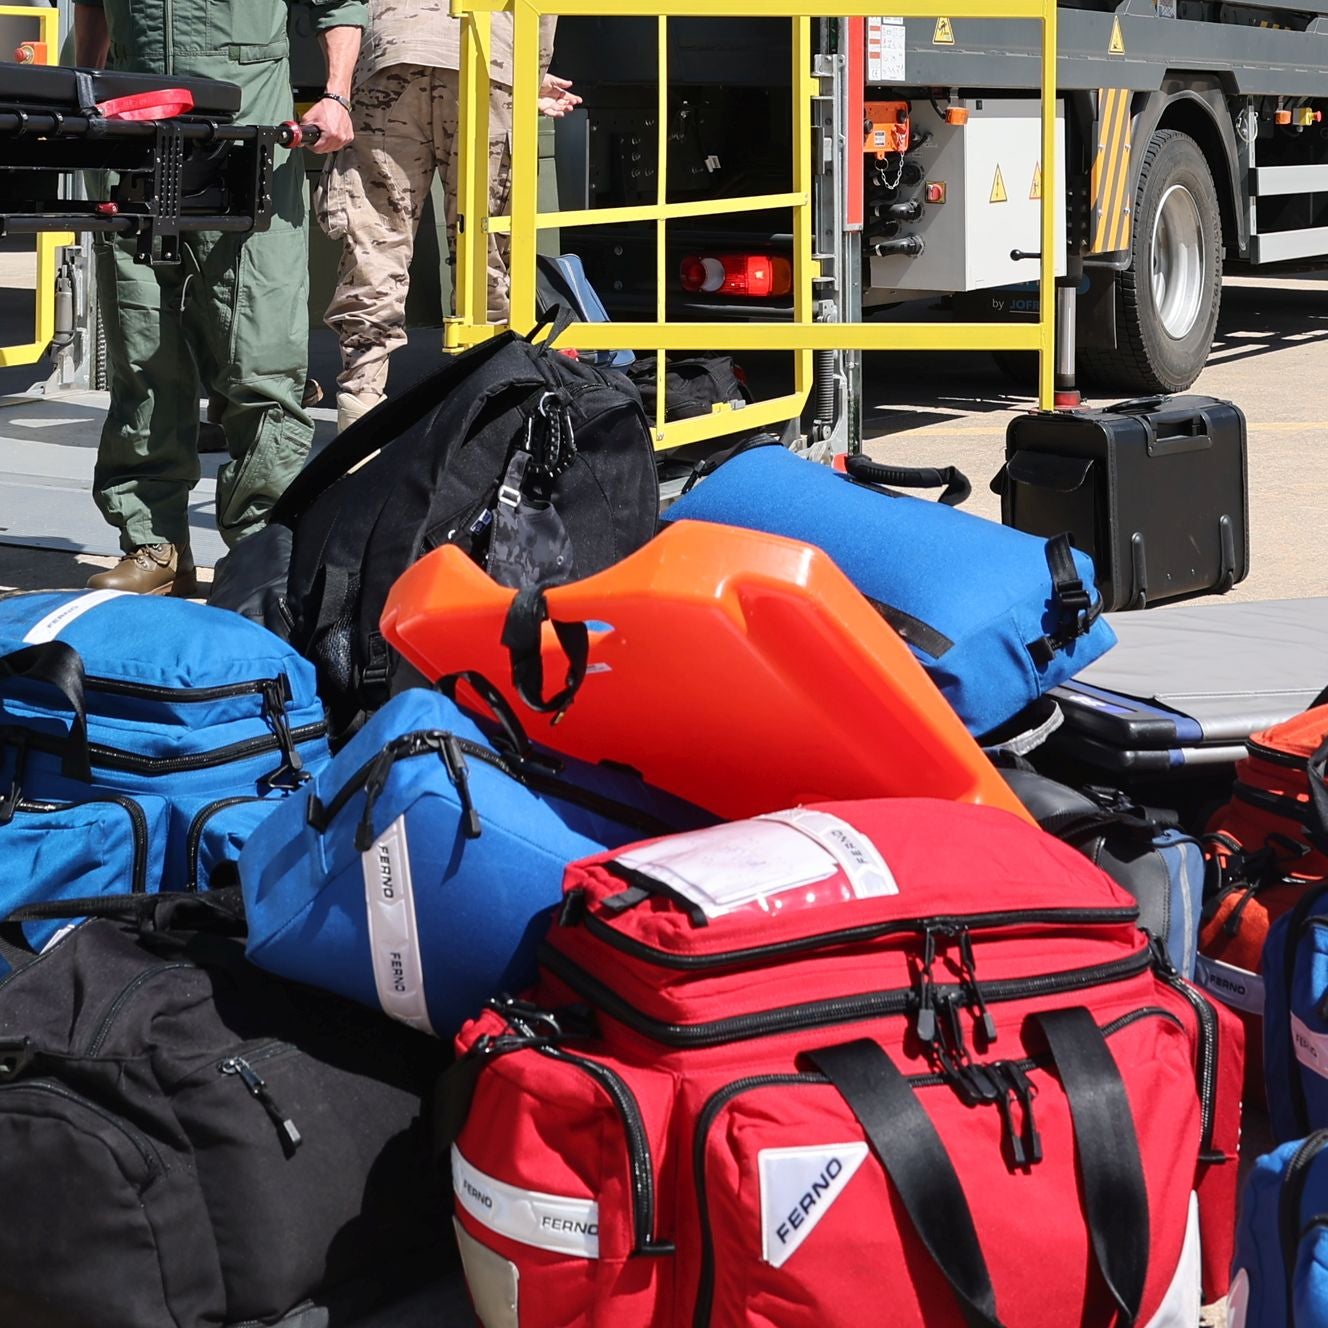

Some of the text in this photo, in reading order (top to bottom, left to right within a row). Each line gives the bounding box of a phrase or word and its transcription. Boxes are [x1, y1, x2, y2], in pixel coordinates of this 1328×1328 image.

[992, 298, 1040, 310] by JOFR
[831, 829, 867, 865] FERNO
[379, 845, 394, 900] FERNO
[390, 952, 406, 993] FERNO
[1209, 973, 1246, 996] FERNO
[1295, 1033, 1318, 1059] FERNO
[463, 1179, 493, 1209] FERNO
[775, 1157, 843, 1245] FERNO
